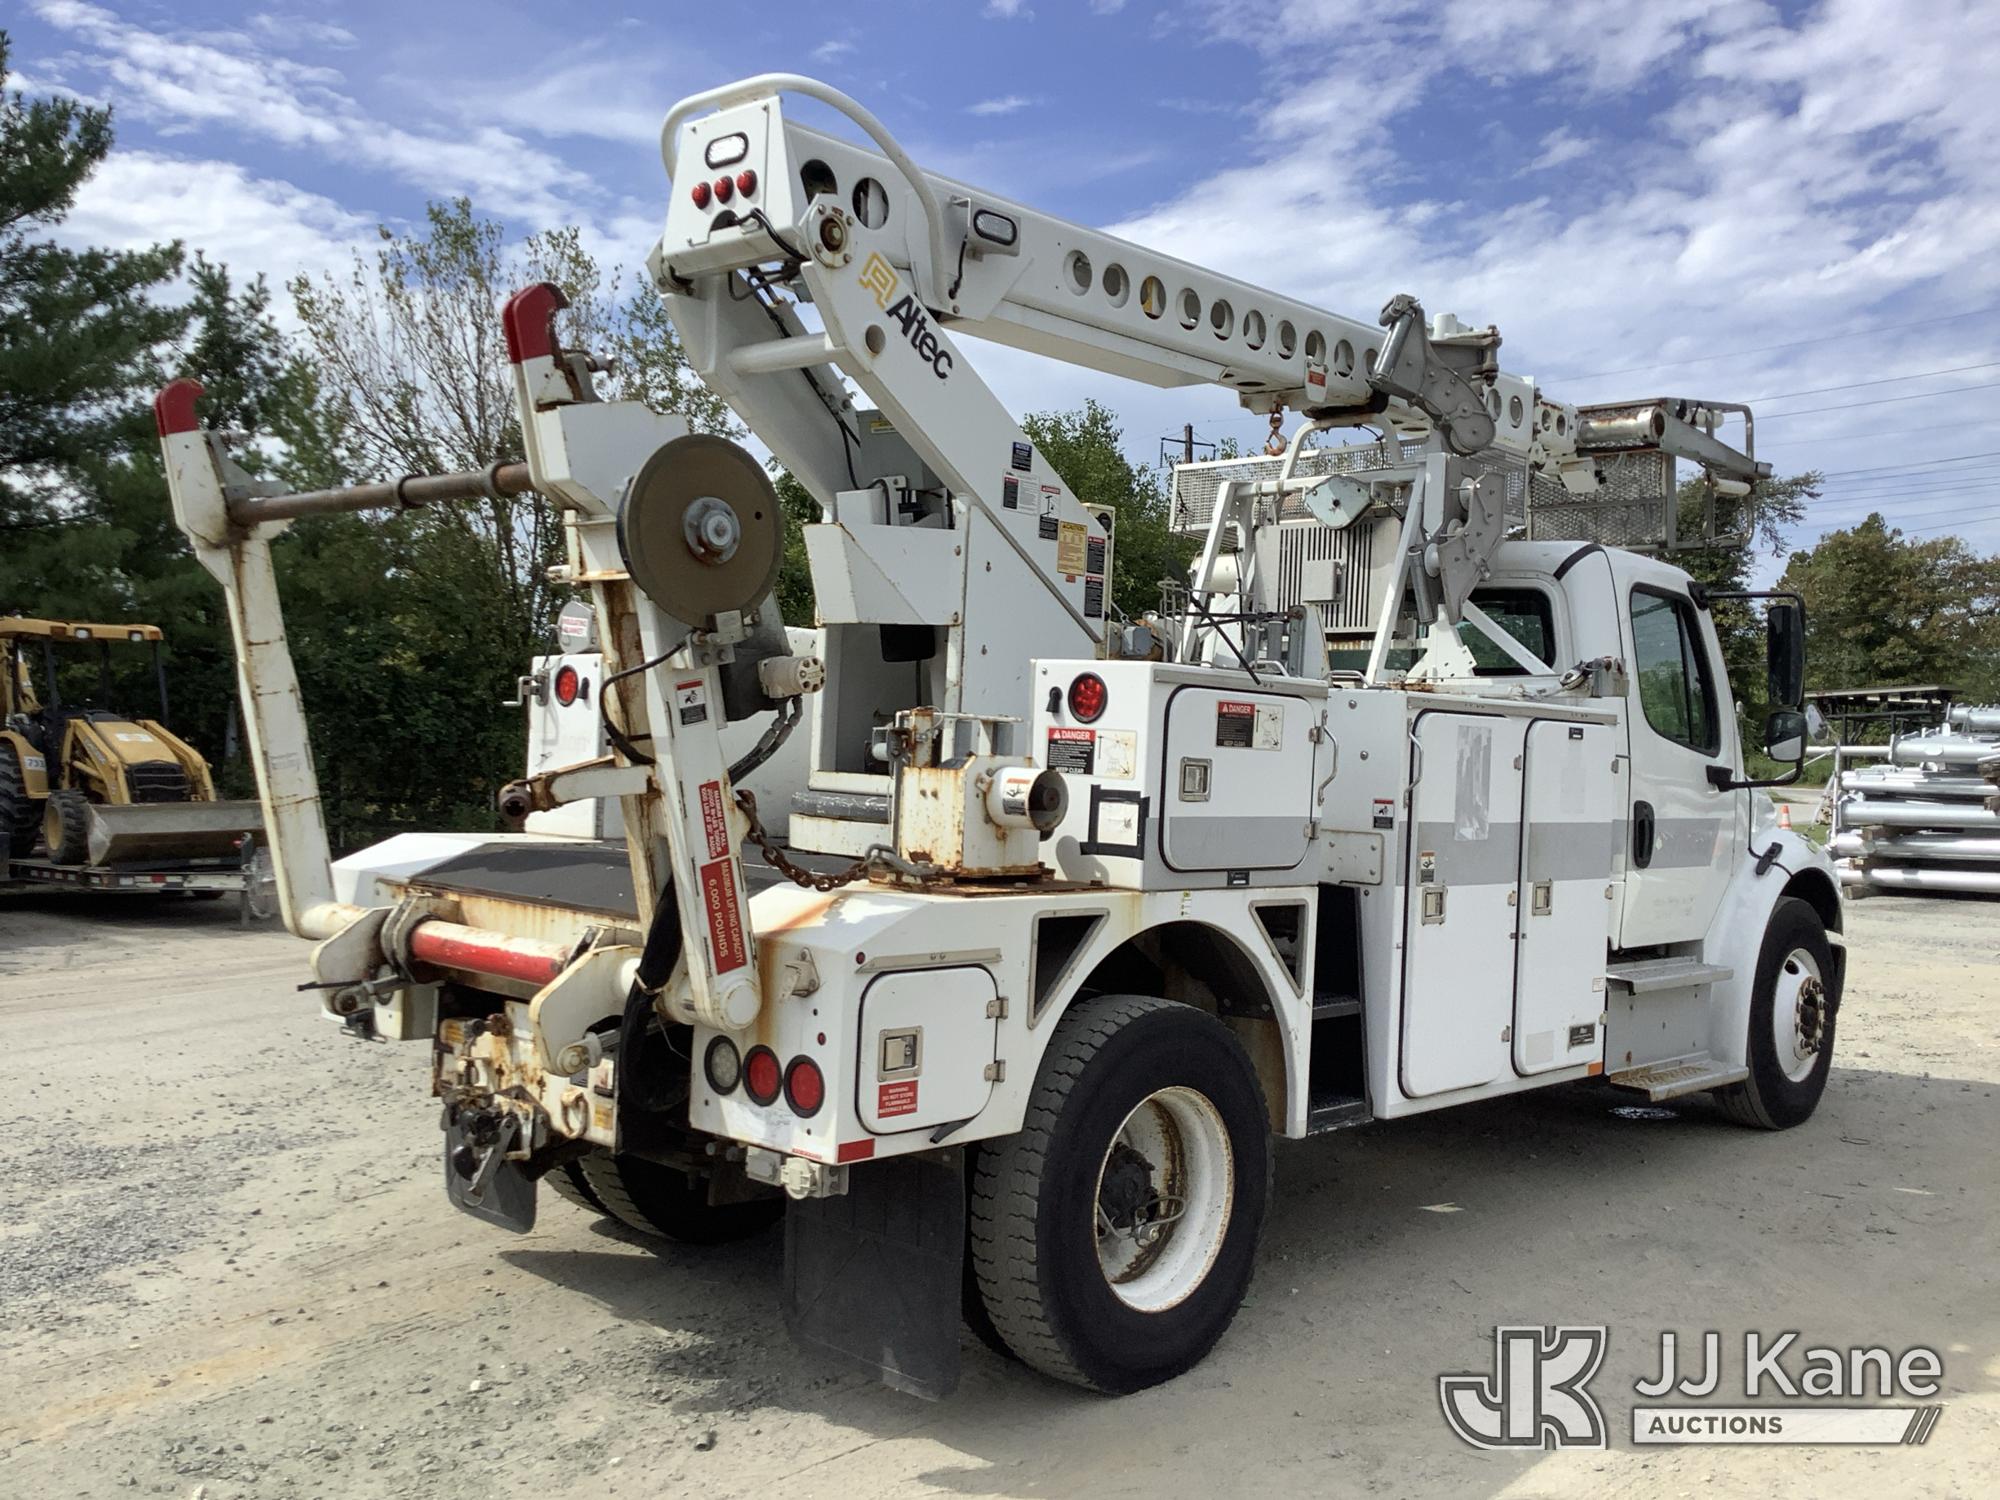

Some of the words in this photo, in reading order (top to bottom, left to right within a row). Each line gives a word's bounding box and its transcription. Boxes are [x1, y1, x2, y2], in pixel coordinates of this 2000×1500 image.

[886, 294, 953, 380] Altec
[1228, 704, 1251, 714] DANGER
[1060, 730, 1091, 740] DANGER
[709, 878, 721, 910] 6,000
[721, 862, 733, 898] MAXIMUM
[726, 898, 738, 928] LIFTING
[714, 912, 729, 958] POUNDS
[731, 927, 744, 963] CAPACITY
